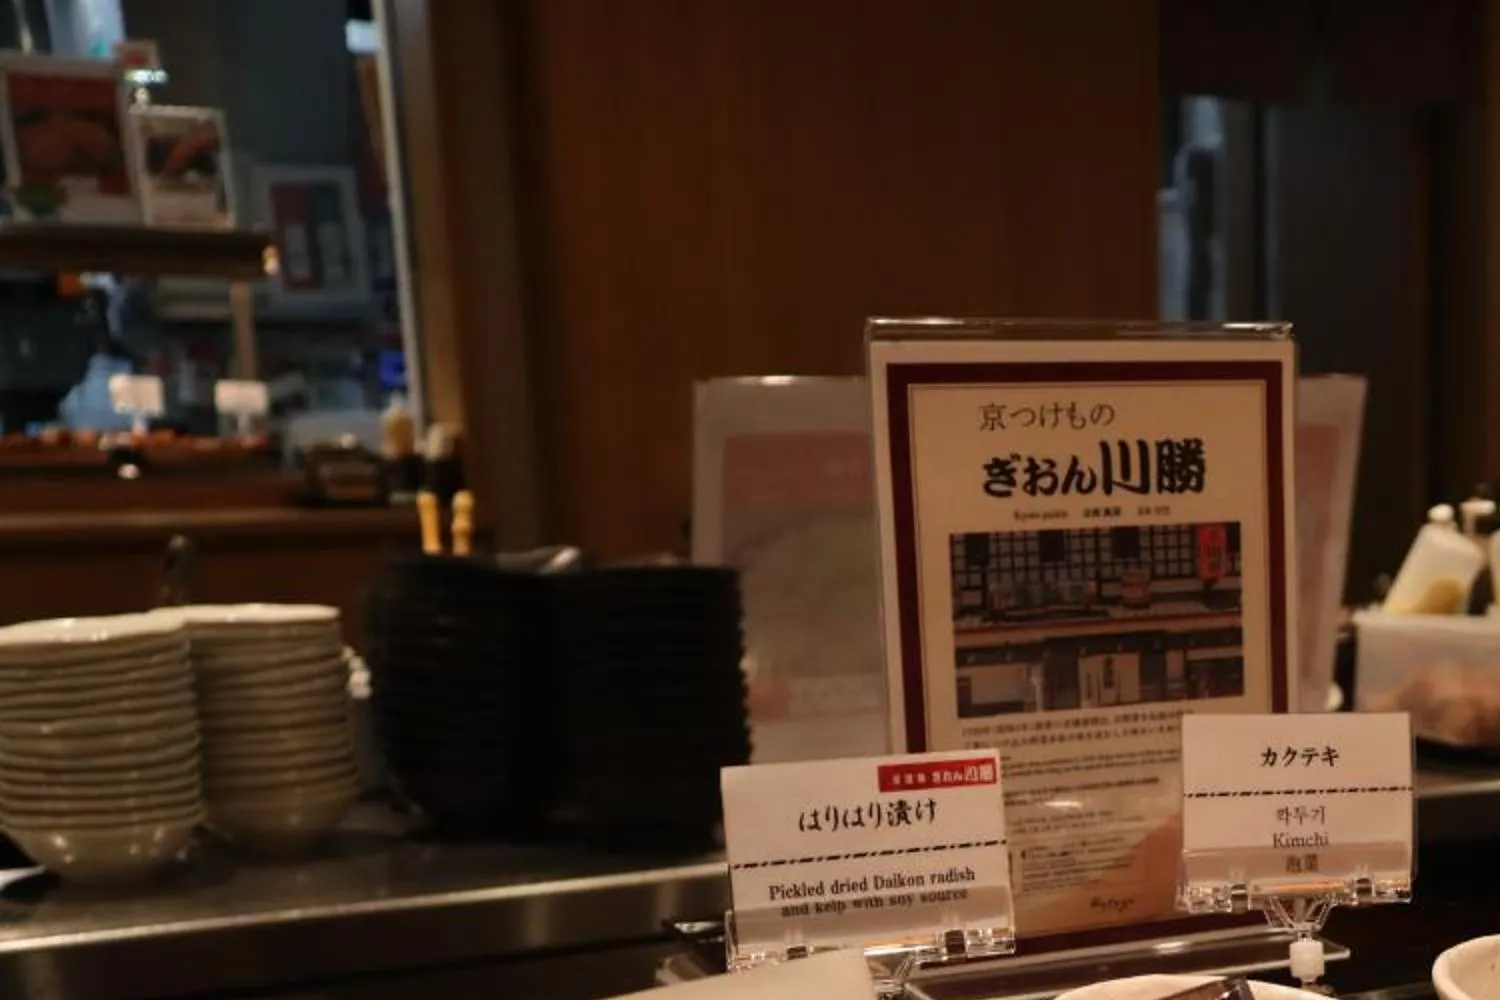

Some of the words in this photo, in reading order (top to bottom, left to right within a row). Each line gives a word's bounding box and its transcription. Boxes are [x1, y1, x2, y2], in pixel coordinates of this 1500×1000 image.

[979, 402, 1115, 431] 京つけもの
[982, 437, 1206, 498] ぎおん川勝
[1260, 746, 1340, 767] カクテキ
[798, 797, 937, 832] はりはり漬け
[1272, 831, 1329, 849] Kimchi
[768, 880, 825, 901] Pickled
[831, 877, 868, 895] dried
[873, 872, 925, 890] Daikon
[930, 867, 976, 885] radish
[781, 902, 810, 917] and
[852, 896, 884, 910] with
